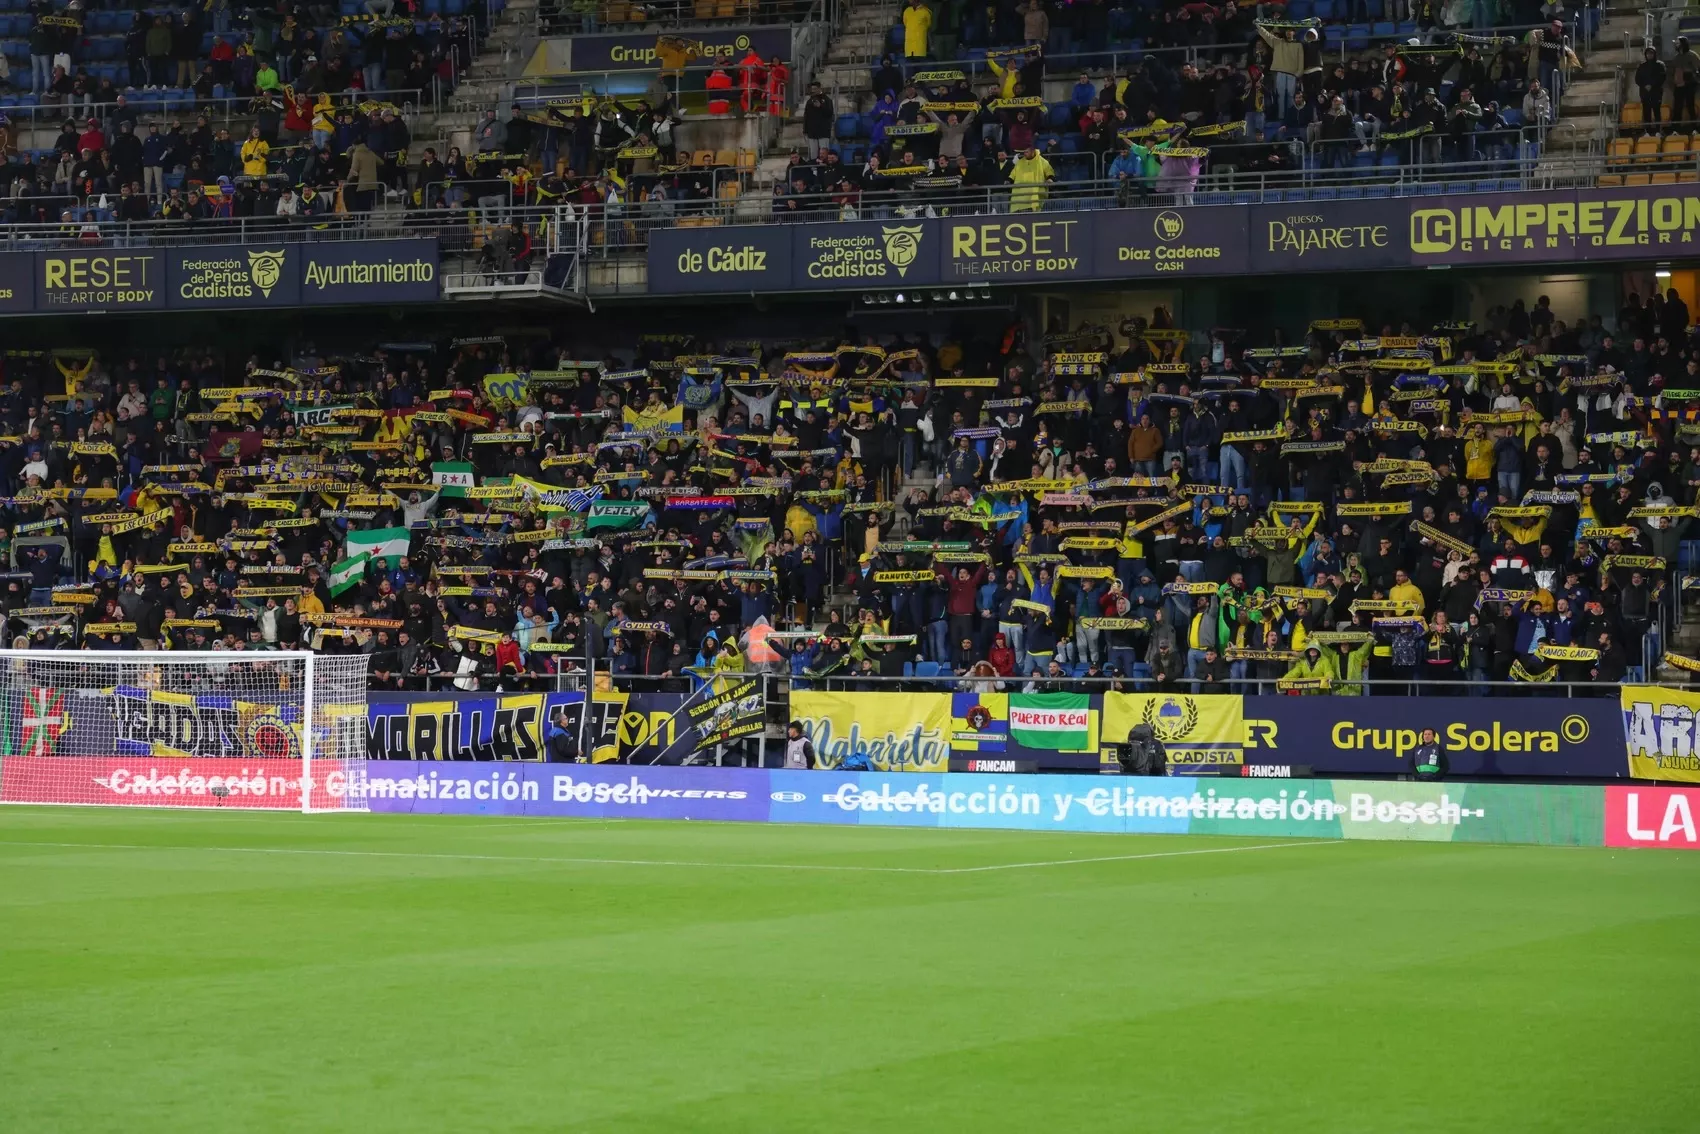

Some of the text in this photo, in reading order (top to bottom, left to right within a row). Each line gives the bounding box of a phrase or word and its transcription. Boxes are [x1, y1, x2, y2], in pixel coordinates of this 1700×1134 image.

[1287, 214, 1324, 226] quesos
[810, 235, 875, 249] Federación
[952, 220, 1078, 258] RESET
[678, 245, 766, 273] de Cádiz
[820, 247, 882, 263] de Peñas
[1118, 244, 1221, 261] Díaz Cadenas
[182, 259, 241, 271] Federación
[808, 261, 887, 279] Cadistas
[953, 257, 1079, 275] THE ART OF BODY
[1155, 260, 1185, 271] CASH
[45, 257, 154, 288] RESET
[191, 270, 248, 284] de Peñas
[304, 259, 434, 290] Ayuntamiento
[46, 290, 153, 304] THE ART OF BODY
[180, 282, 252, 300] Cadistas
[1061, 354, 1084, 362] CADIZ
[296, 409, 330, 425] ARC
[441, 474, 467, 484] B A
[592, 505, 641, 518] VEJER
[1346, 505, 1376, 513] Somos
[1636, 507, 1665, 515] Somos
[94, 513, 117, 521] CADIZ
[519, 532, 542, 541] CADIZ
[1585, 528, 1613, 537] CADIZ
[1446, 721, 1560, 753] Solera
[1172, 751, 1237, 764] CADISTA
[967, 760, 1016, 773] #FANCAM
[1239, 764, 1291, 778] #FANCAM
[553, 775, 648, 805] Bosch
[836, 783, 1040, 817] Calefacción
[1053, 793, 1073, 822] y
[1350, 793, 1462, 826] Bosch
